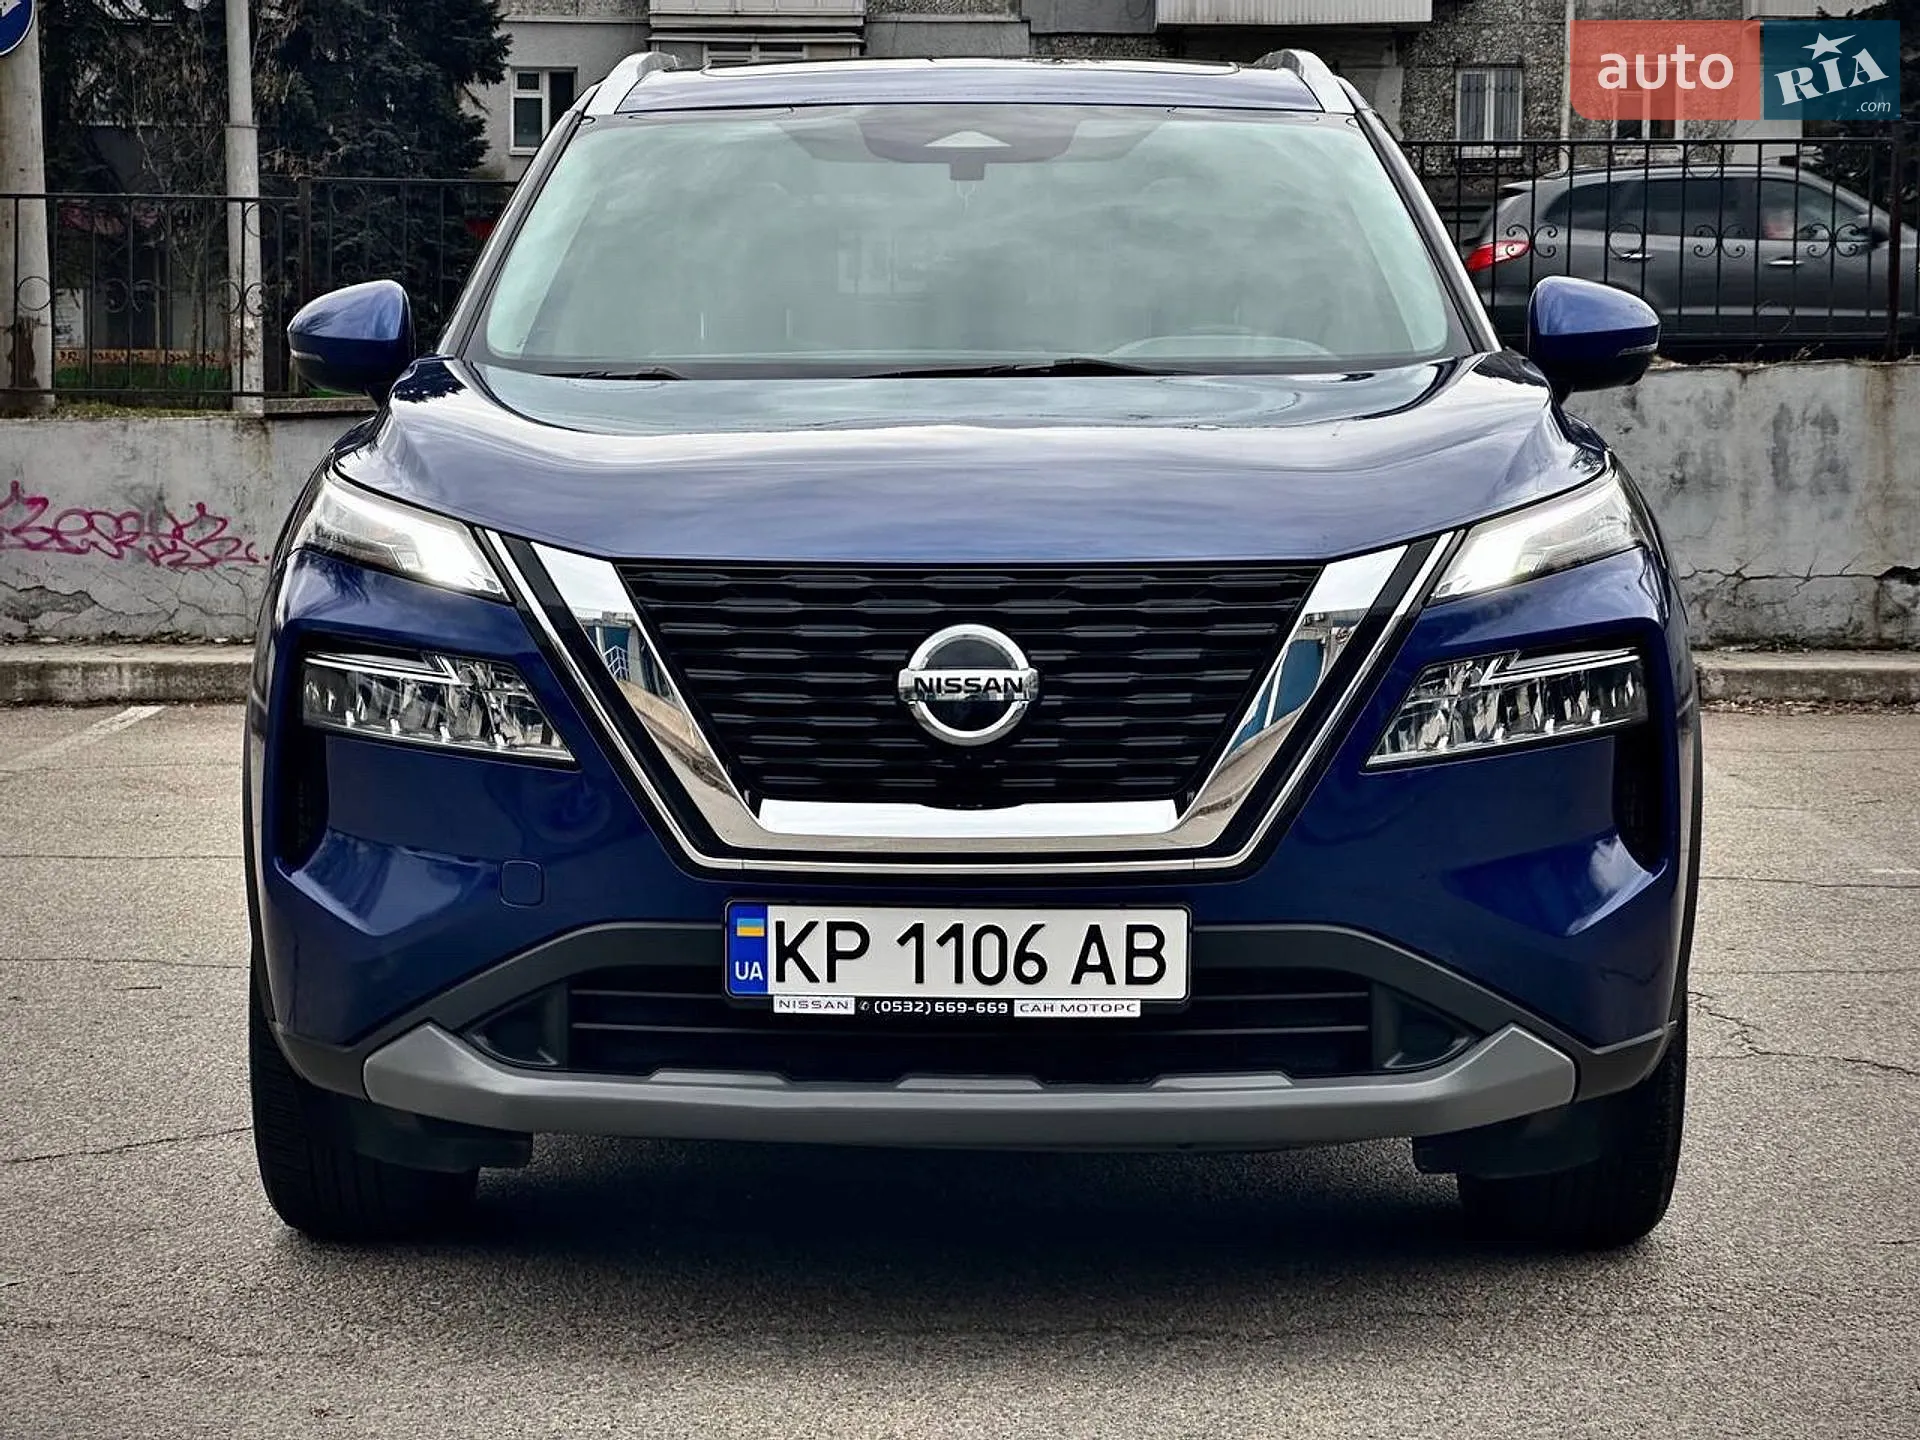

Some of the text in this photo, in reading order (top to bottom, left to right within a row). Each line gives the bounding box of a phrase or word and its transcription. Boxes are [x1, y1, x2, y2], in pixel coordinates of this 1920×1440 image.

[914, 677, 1023, 694] NISSAN
[775, 920, 1167, 986] KP 1106 AB
[735, 961, 764, 981] UA
[778, 999, 849, 1011] NISSAN
[1019, 1002, 1137, 1014] САН МОТОРС
